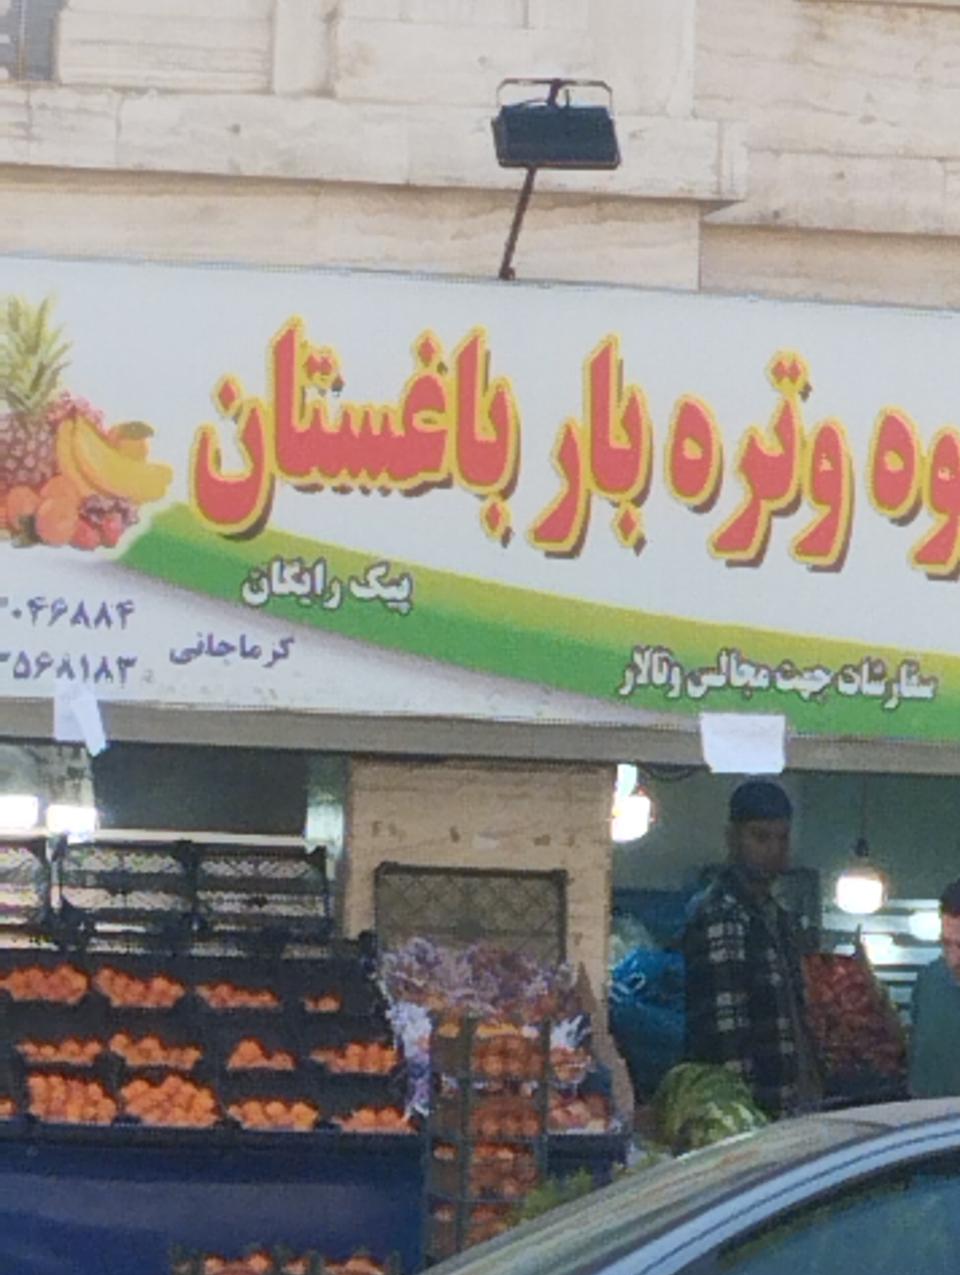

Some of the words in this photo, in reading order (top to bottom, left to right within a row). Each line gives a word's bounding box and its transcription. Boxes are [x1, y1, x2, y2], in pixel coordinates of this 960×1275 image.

[189, 314, 521, 547] باغستان
[526, 334, 653, 557] بار
[241, 555, 343, 609] رایگان
[349, 560, 412, 616] پیک
[685, 648, 772, 699] مجالس
[772, 659, 834, 703] جهت
